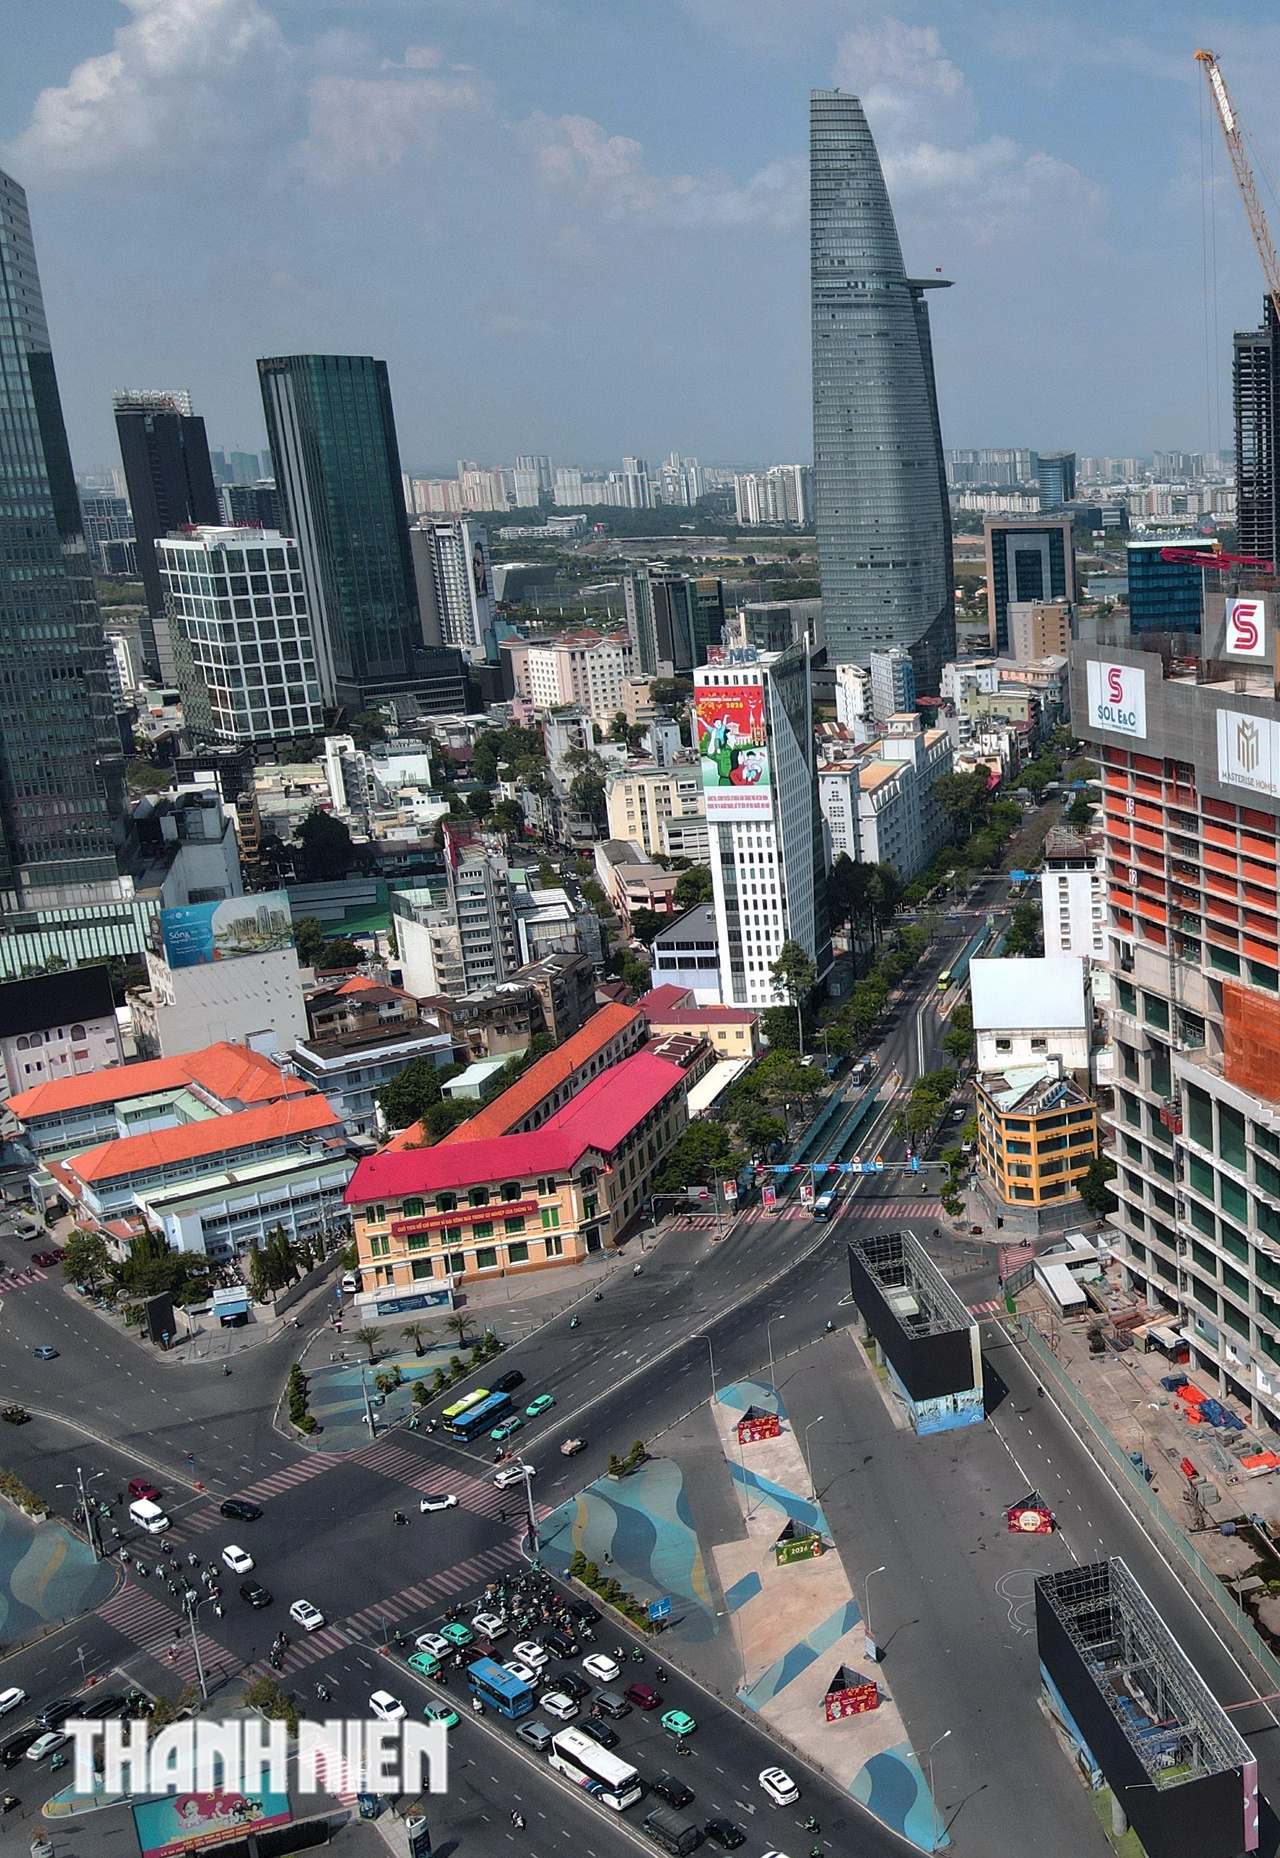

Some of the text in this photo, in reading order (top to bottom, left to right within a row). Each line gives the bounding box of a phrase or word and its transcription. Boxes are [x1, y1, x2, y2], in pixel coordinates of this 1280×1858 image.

[730, 647, 757, 664] MB
[1097, 704, 1137, 726] SOL E&C
[1221, 770, 1278, 793] MASTERISE HOMES
